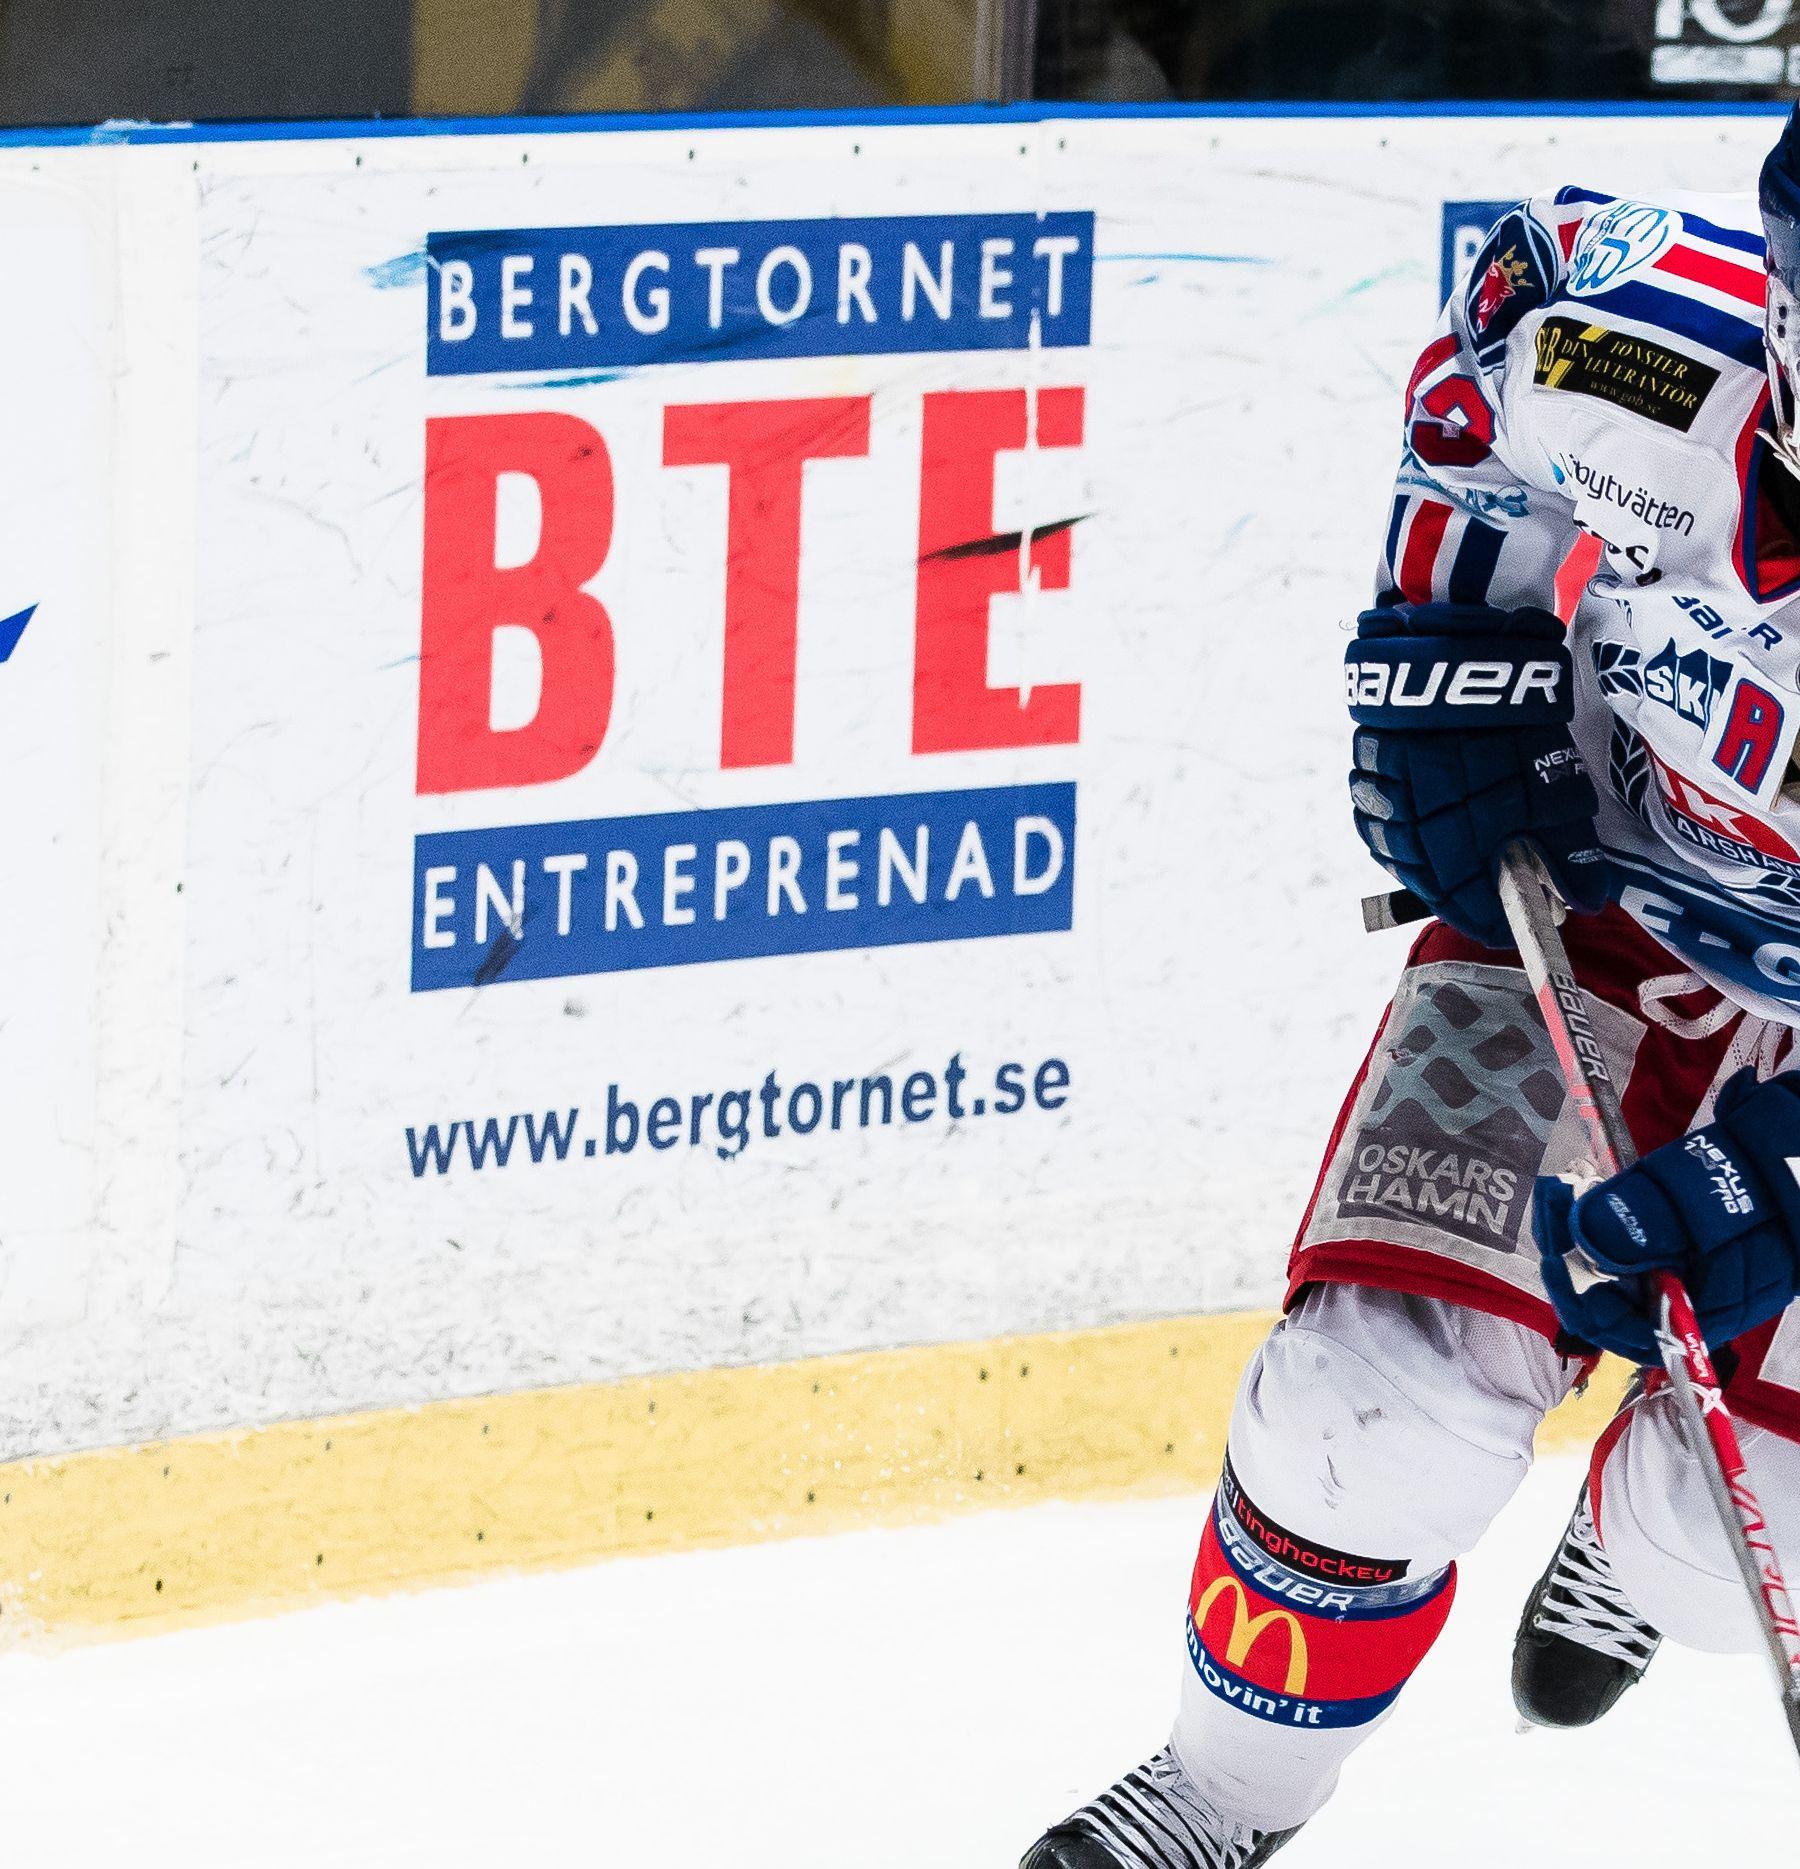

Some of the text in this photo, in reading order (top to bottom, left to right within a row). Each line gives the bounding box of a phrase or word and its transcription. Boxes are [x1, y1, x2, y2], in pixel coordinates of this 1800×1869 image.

[438, 236, 1081, 342] BERGTORNET
[416, 386, 1086, 797] BTE
[1712, 677, 1785, 796] A
[422, 816, 1065, 949] ENTREPRENAD
[1553, 973, 1611, 1082] BAUER
[405, 1052, 1071, 1179] www.bergtornet.se
[1345, 1173, 1509, 1235] HAMN
[1358, 1143, 1518, 1202] OSKARS
[1691, 1134, 1755, 1214] NEXUS
[1218, 1516, 1356, 1612] BAUER
[1198, 1648, 1288, 1716] lovin'
[1293, 1702, 1323, 1725] it
